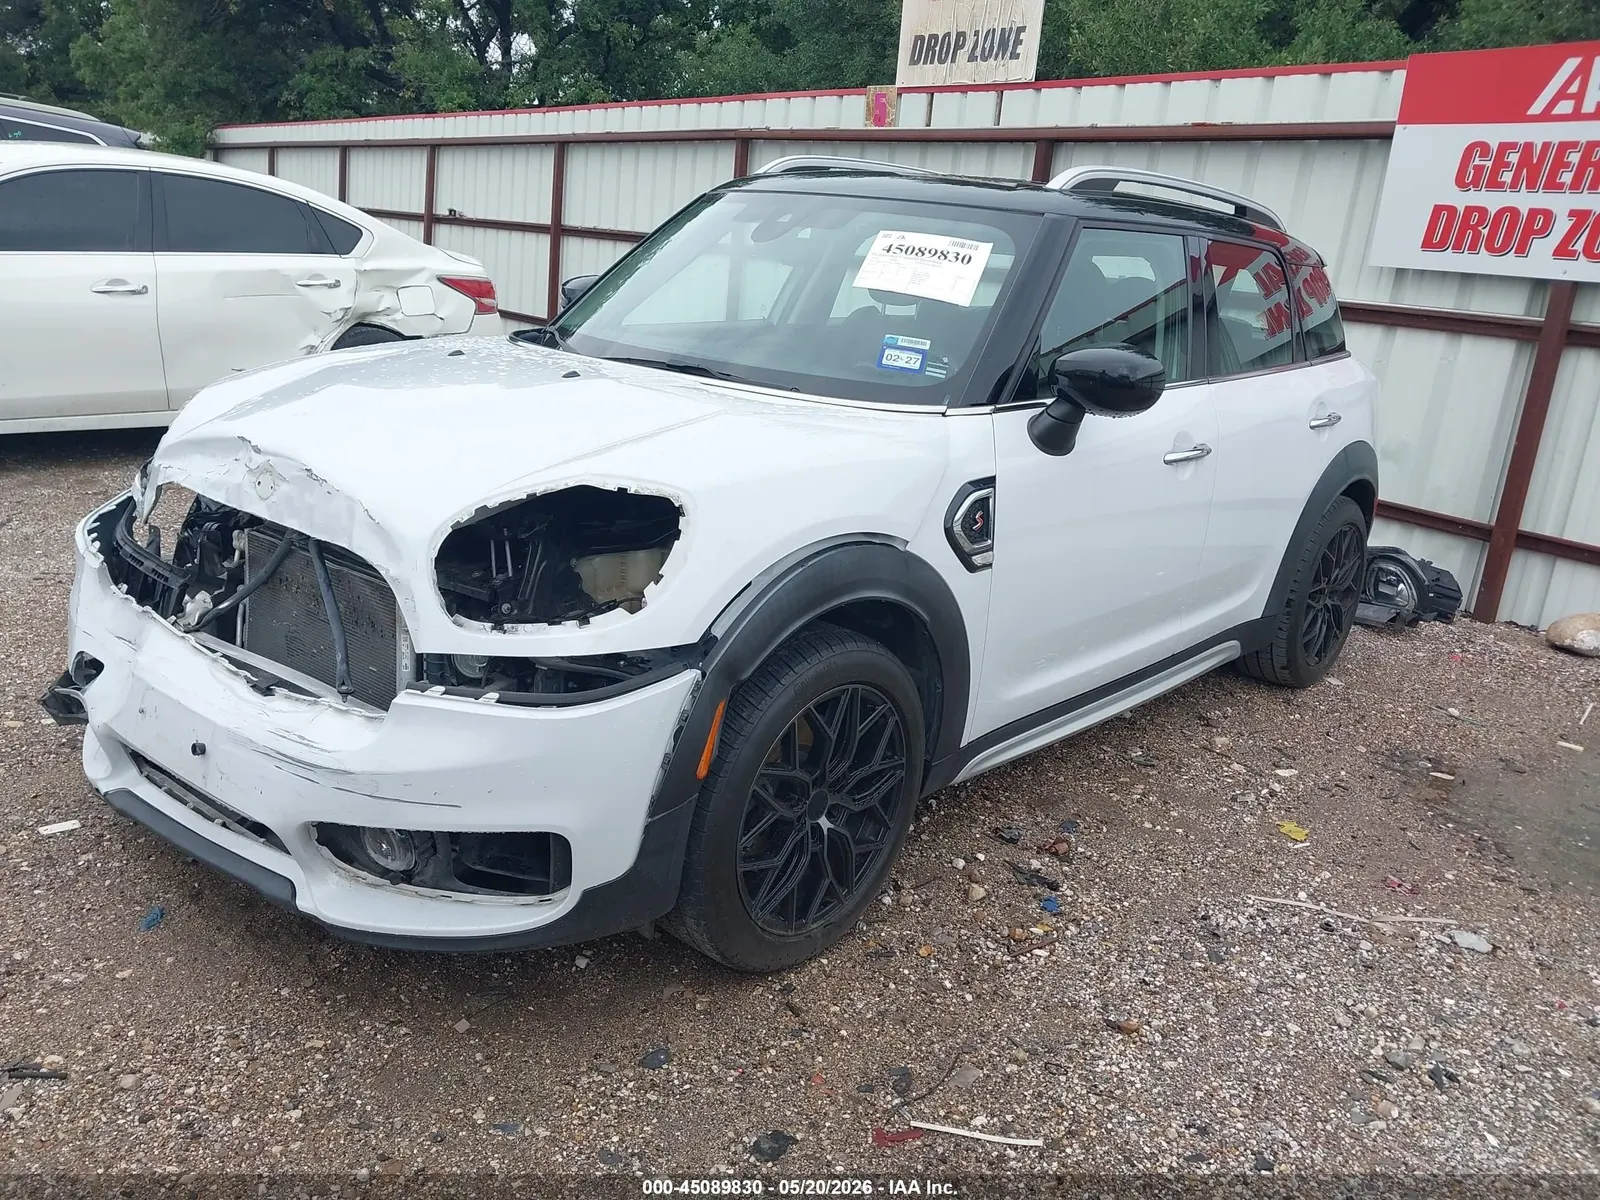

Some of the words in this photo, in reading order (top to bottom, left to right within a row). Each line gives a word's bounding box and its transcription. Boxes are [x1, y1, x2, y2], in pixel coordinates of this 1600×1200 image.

[908, 30, 967, 66] DROP
[967, 26, 1027, 63] ZONE
[872, 91, 888, 128] 5
[1420, 203, 1557, 259] DROP
[882, 243, 973, 266] 45089830
[885, 353, 900, 363] 02
[905, 356, 920, 365] 27
